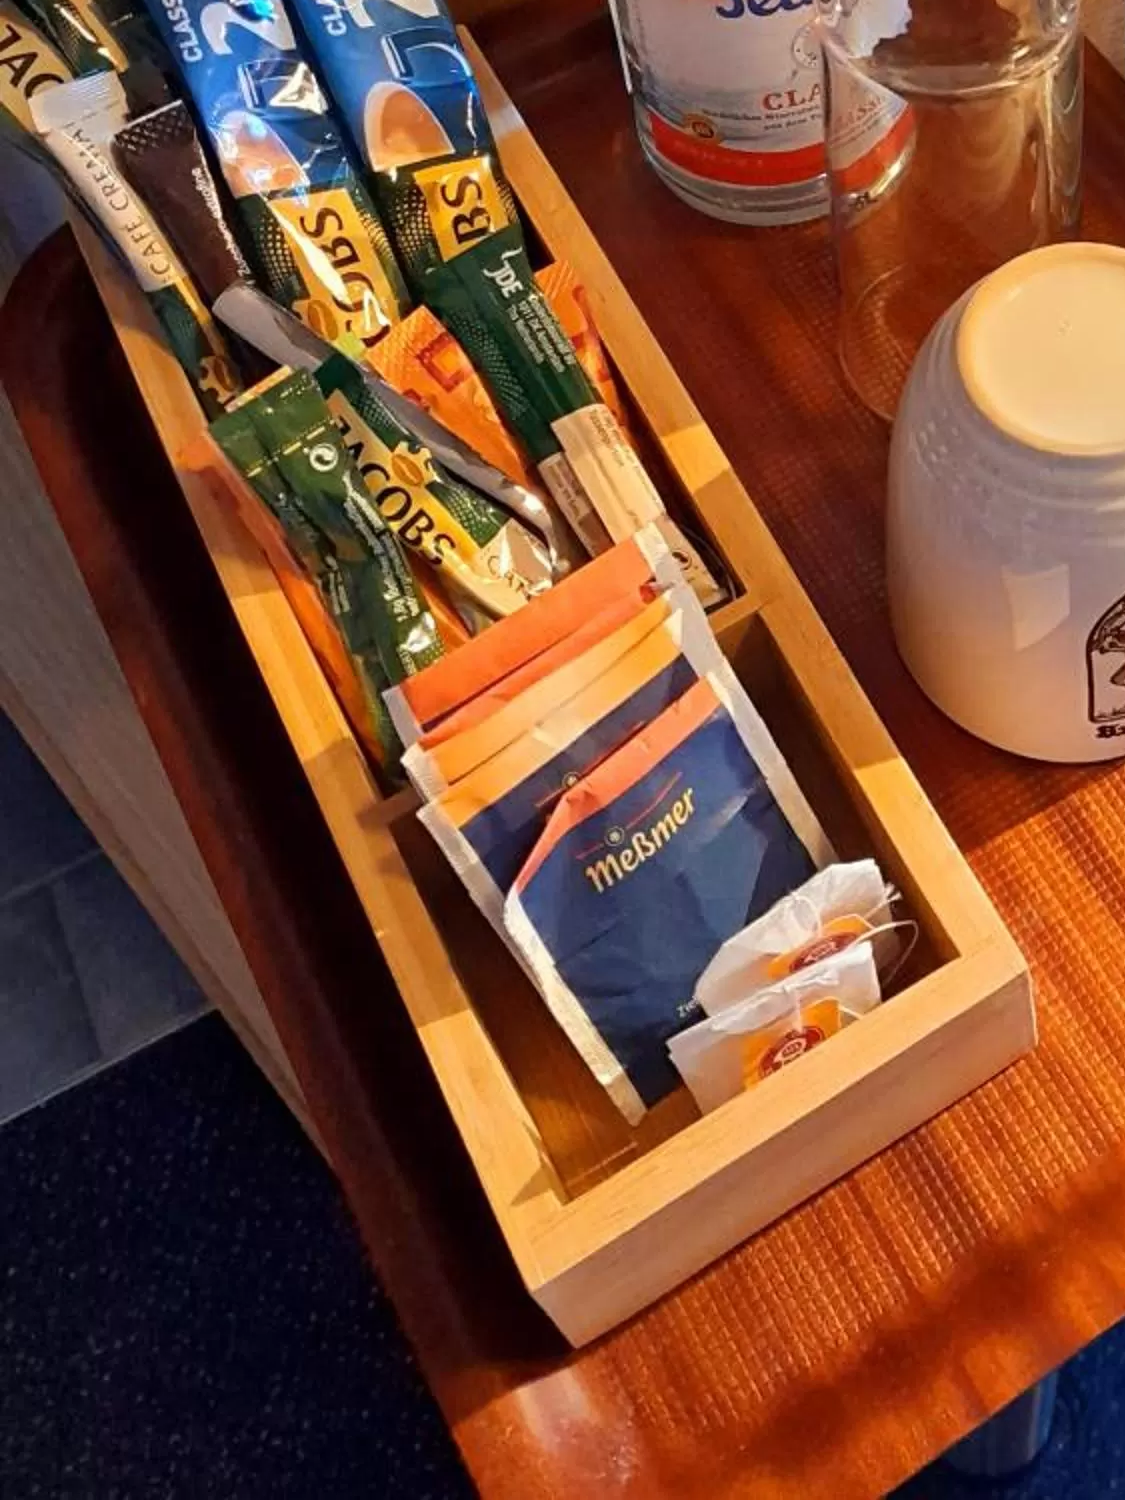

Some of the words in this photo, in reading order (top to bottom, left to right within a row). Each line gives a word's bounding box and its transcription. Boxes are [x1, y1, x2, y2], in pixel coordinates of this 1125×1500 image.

[0, 23, 65, 100] JAC
[72, 129, 129, 212] CREMA
[483, 259, 523, 298] JDE
[585, 787, 695, 893] Meßmer
